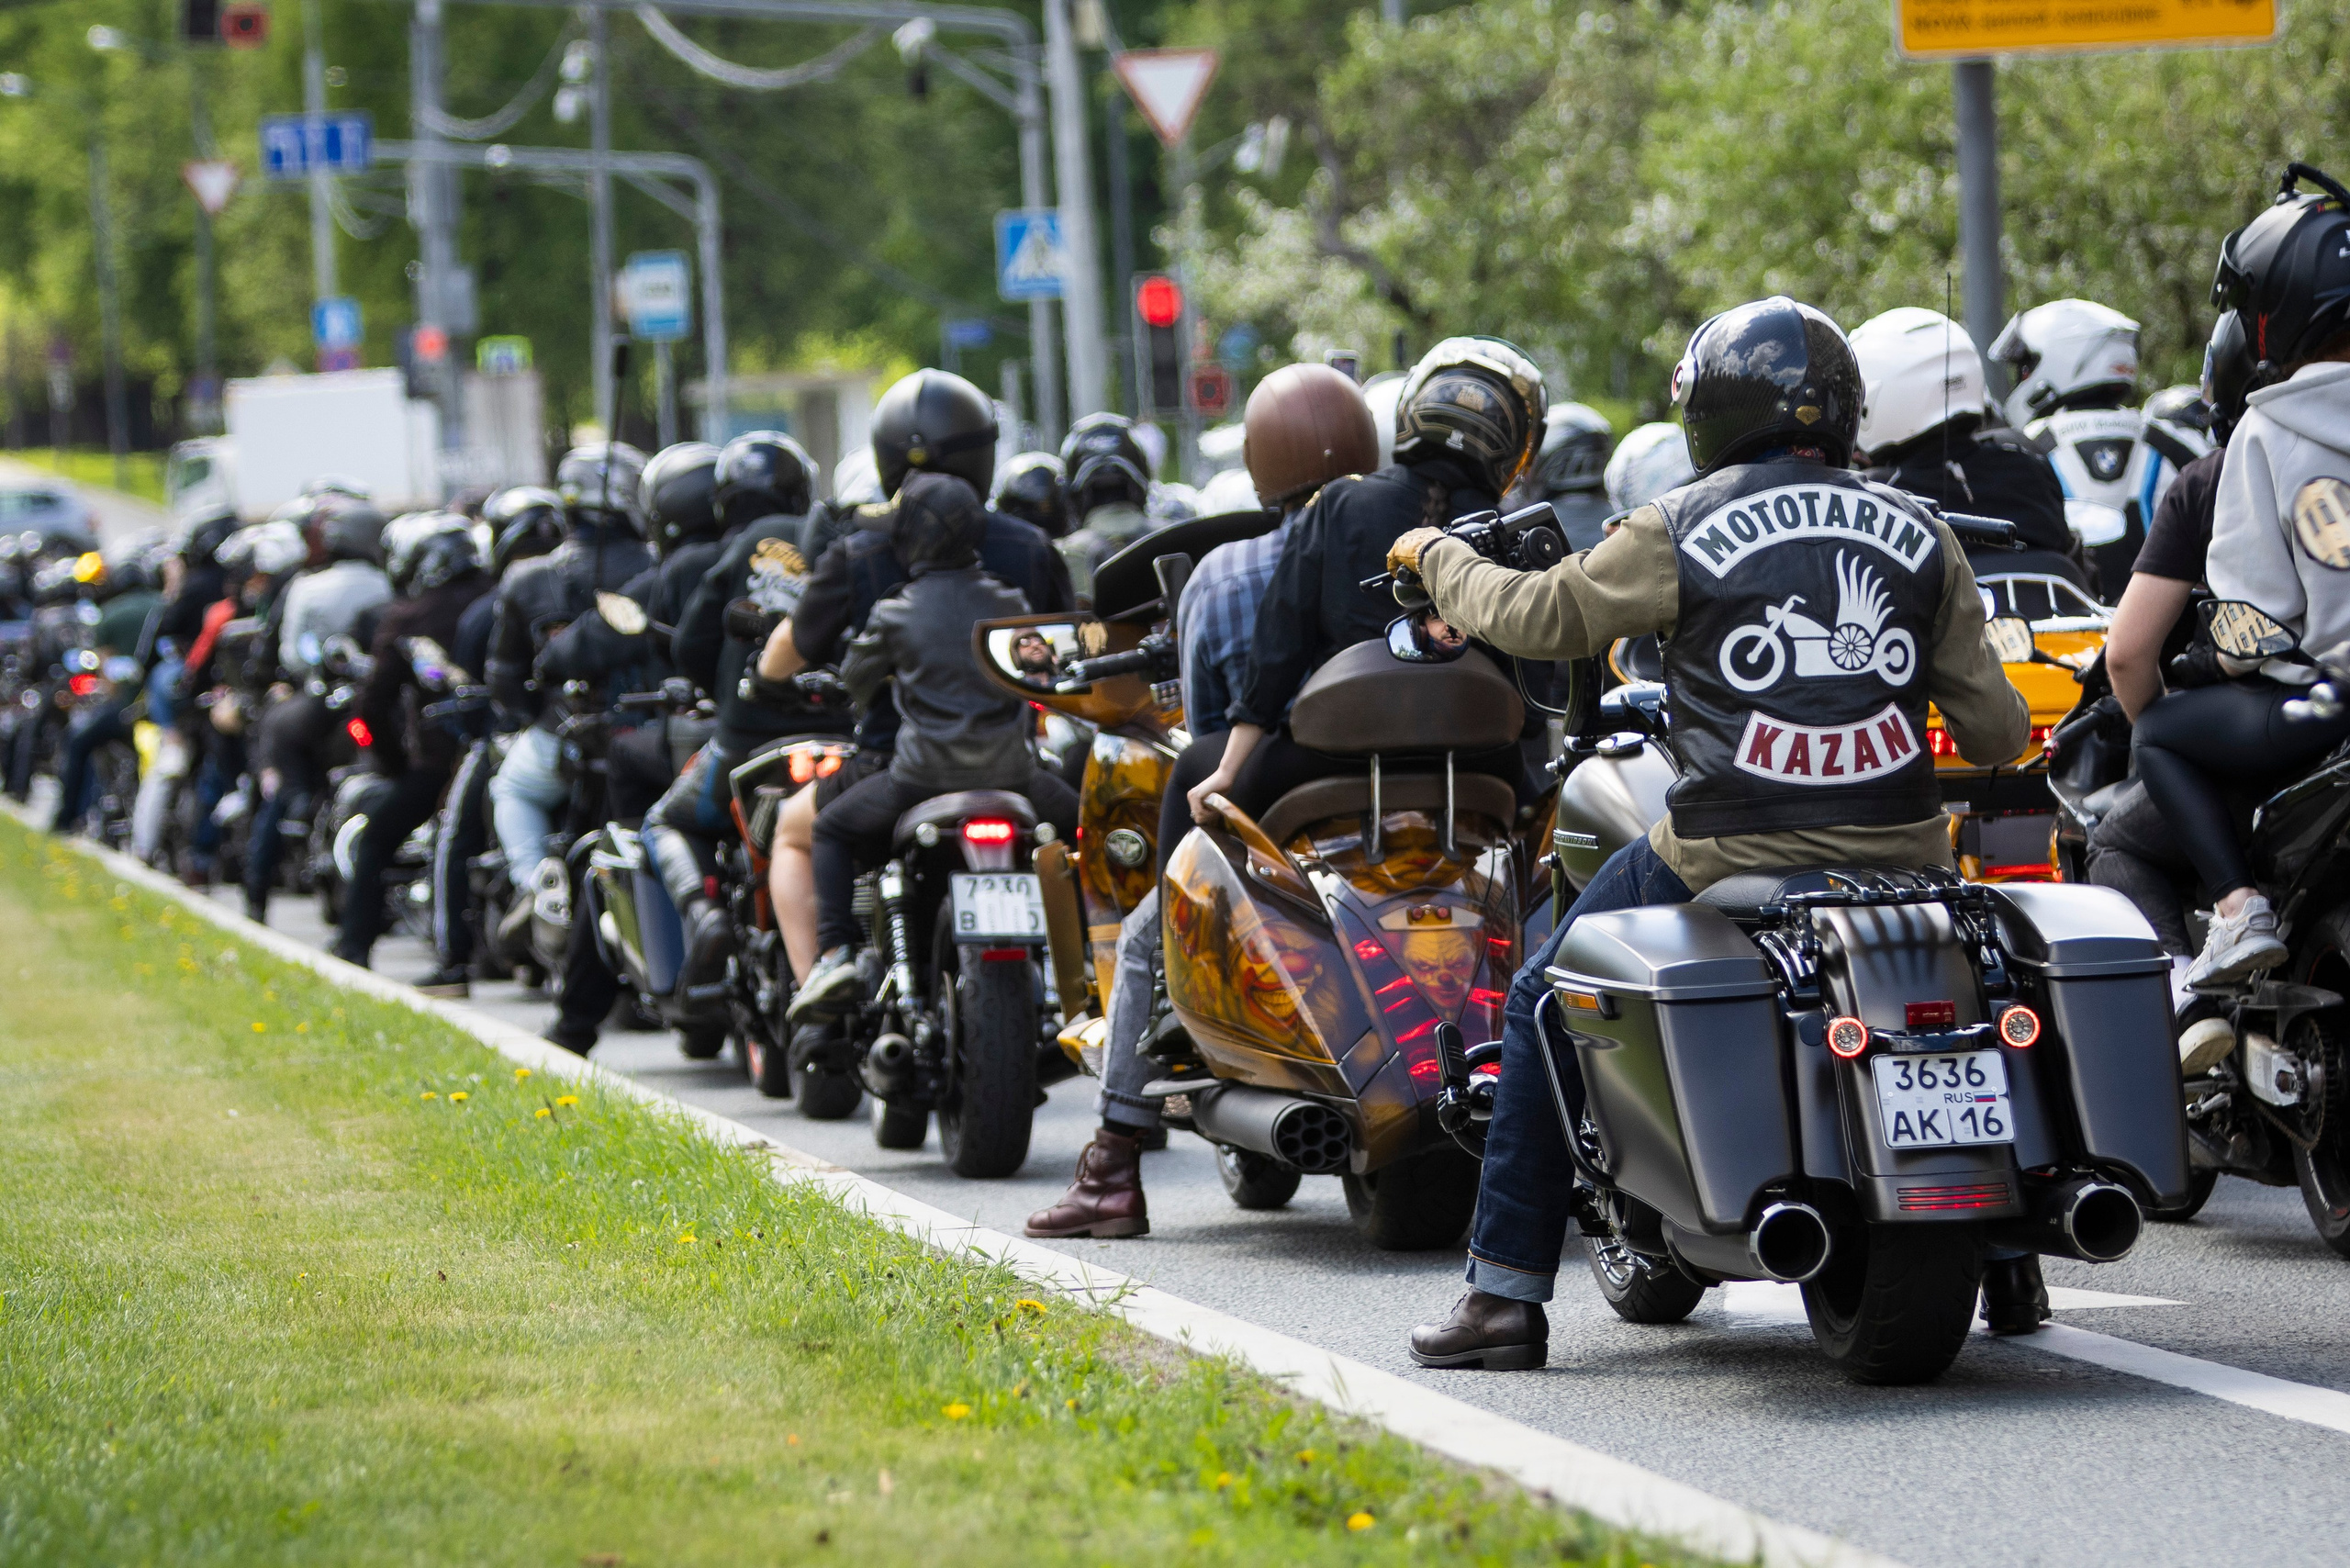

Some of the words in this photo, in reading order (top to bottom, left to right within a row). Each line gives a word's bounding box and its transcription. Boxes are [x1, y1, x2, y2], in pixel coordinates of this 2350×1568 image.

[1693, 491, 1927, 566] MOTOTARIN
[1746, 712, 1912, 777] KAZAN
[1892, 1057, 1986, 1091] 3636
[1944, 1092, 1974, 1103] RUS
[1892, 1108, 1943, 1142] AK
[1959, 1106, 2003, 1137] 16
